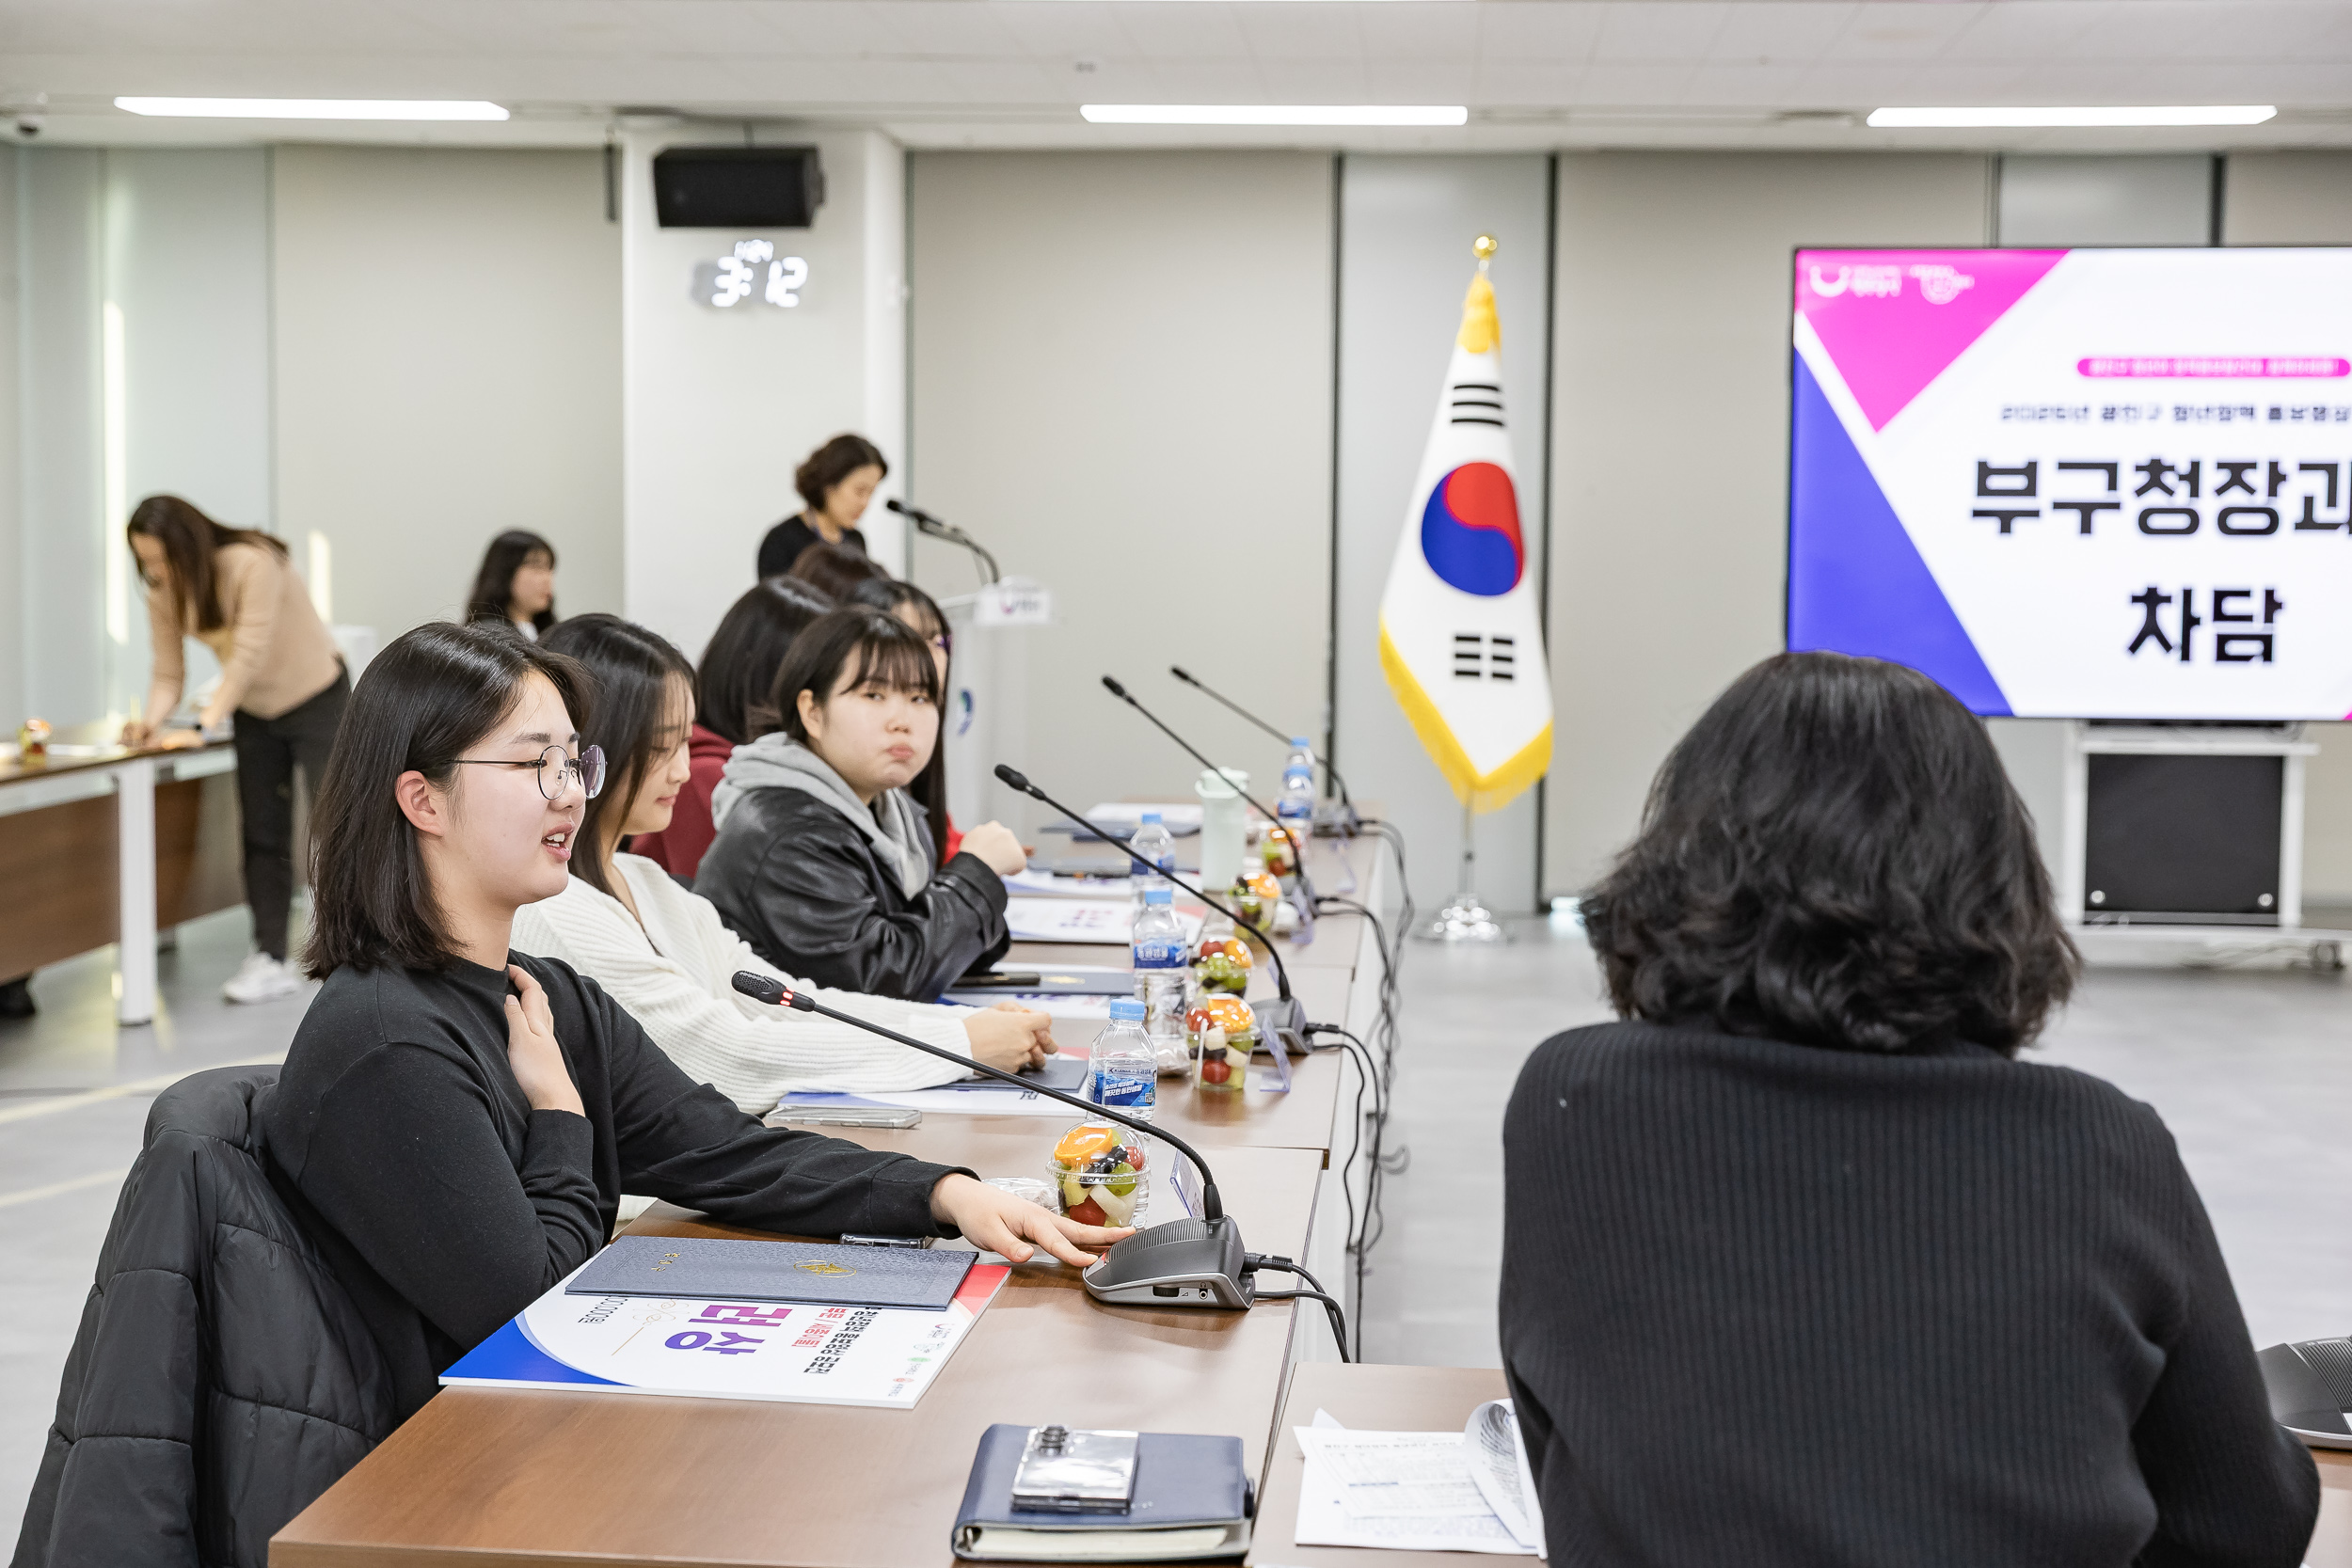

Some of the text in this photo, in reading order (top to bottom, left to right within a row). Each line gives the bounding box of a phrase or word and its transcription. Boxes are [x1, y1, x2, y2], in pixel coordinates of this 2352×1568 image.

[711, 256, 808, 309] 3:12
[1972, 457, 2352, 536] 부구청장과
[2127, 586, 2283, 664] 차담
[578, 1296, 628, 1323] 00,000원
[820, 1333, 860, 1355] 홍보영상
[803, 1356, 841, 1374] 공모전
